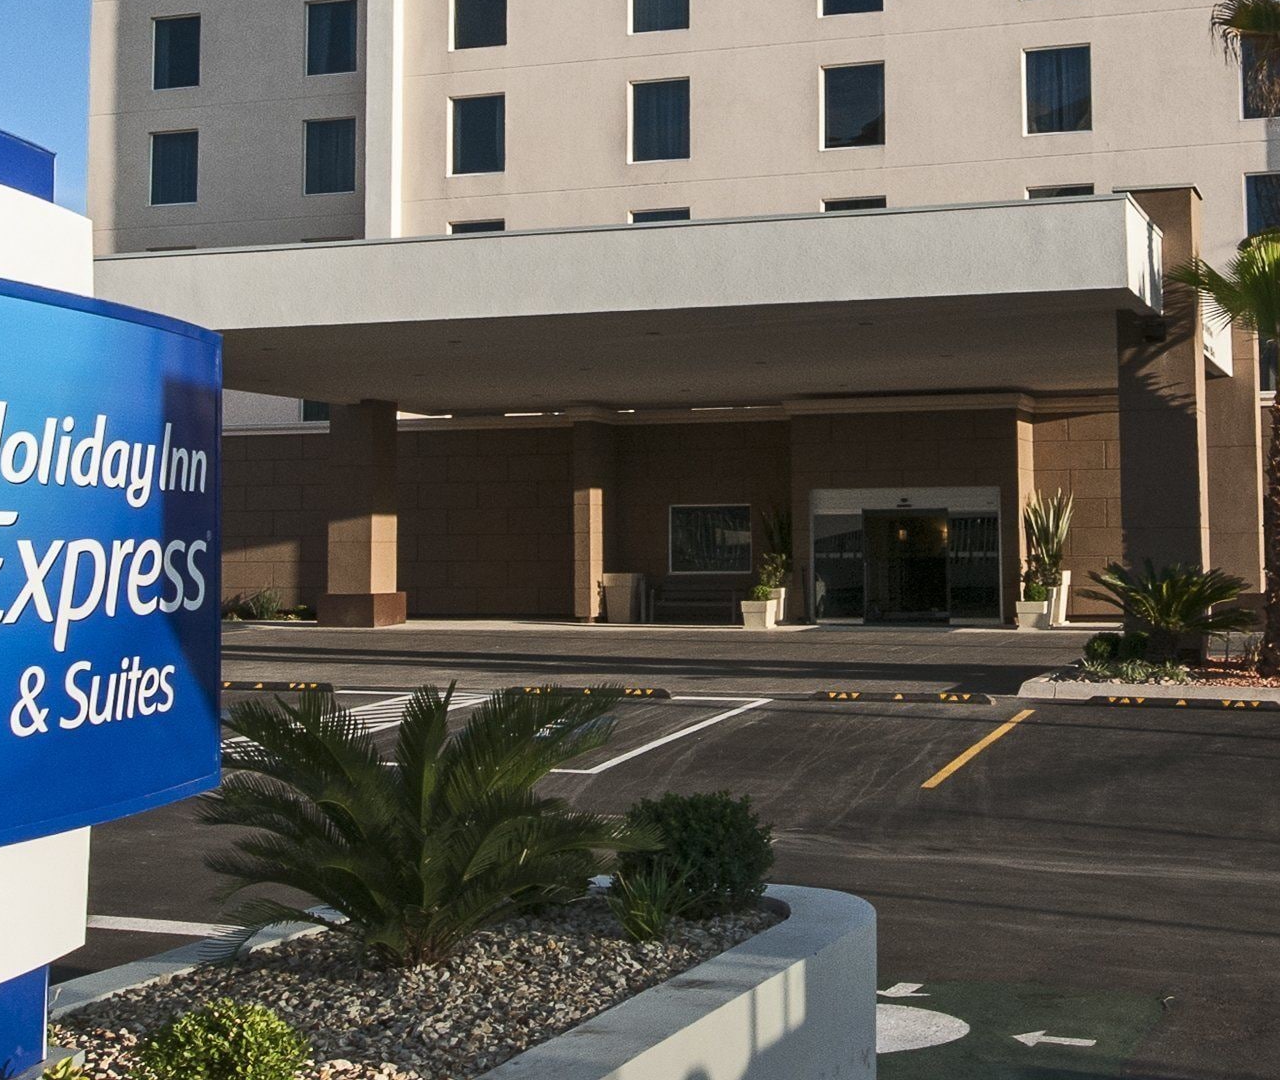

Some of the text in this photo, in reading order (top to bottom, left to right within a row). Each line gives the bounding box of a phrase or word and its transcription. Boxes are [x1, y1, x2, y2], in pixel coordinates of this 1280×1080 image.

[160, 422, 207, 493] Inn
[10, 656, 175, 737] & Suites
